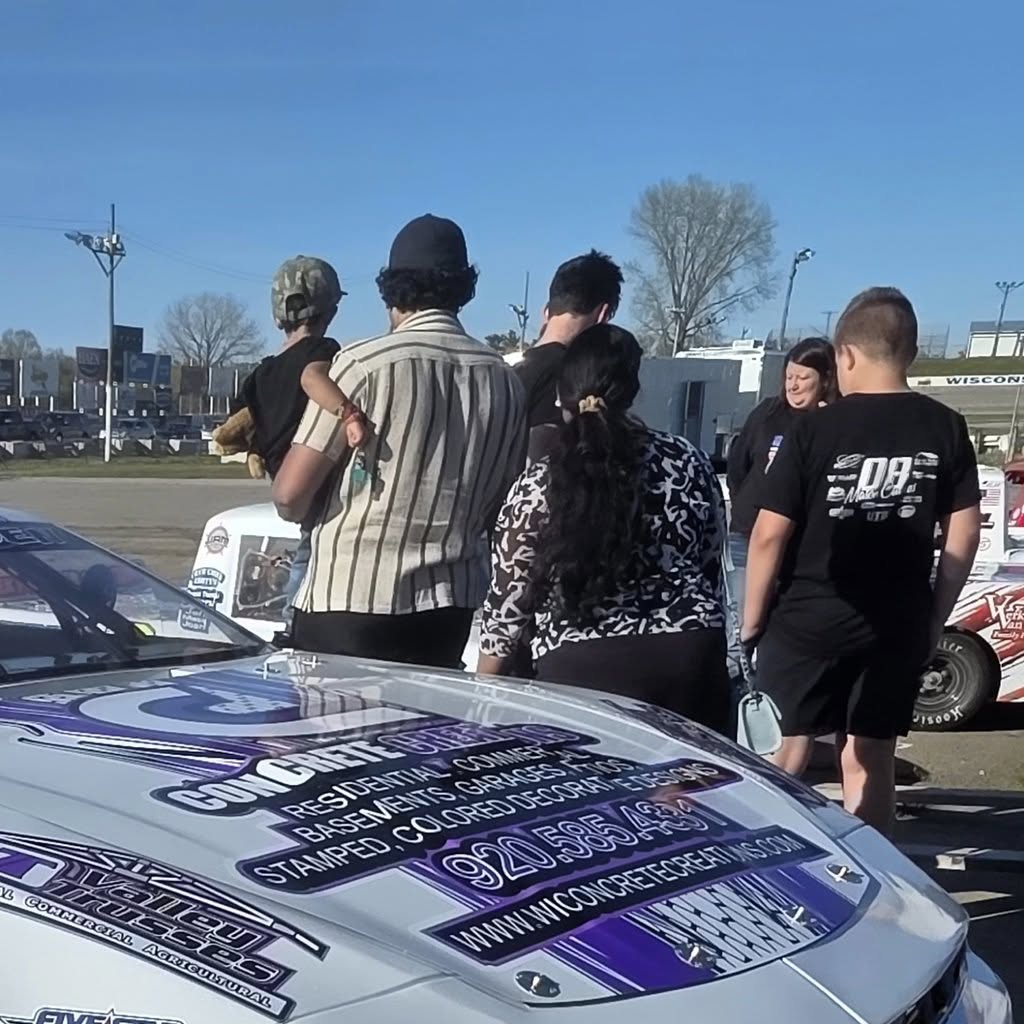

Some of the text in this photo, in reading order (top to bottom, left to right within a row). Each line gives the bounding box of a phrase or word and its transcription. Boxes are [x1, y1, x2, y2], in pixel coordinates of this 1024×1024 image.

[946, 376, 1024, 385] WISCON
[857, 457, 913, 491] 08
[167, 739, 407, 811] CONCRETE
[453, 745, 591, 774] COMMERAL
[392, 798, 517, 844] COLORED
[628, 763, 719, 789] DESIGNS
[46, 879, 280, 984] Trusses
[78, 869, 263, 949] Valley
